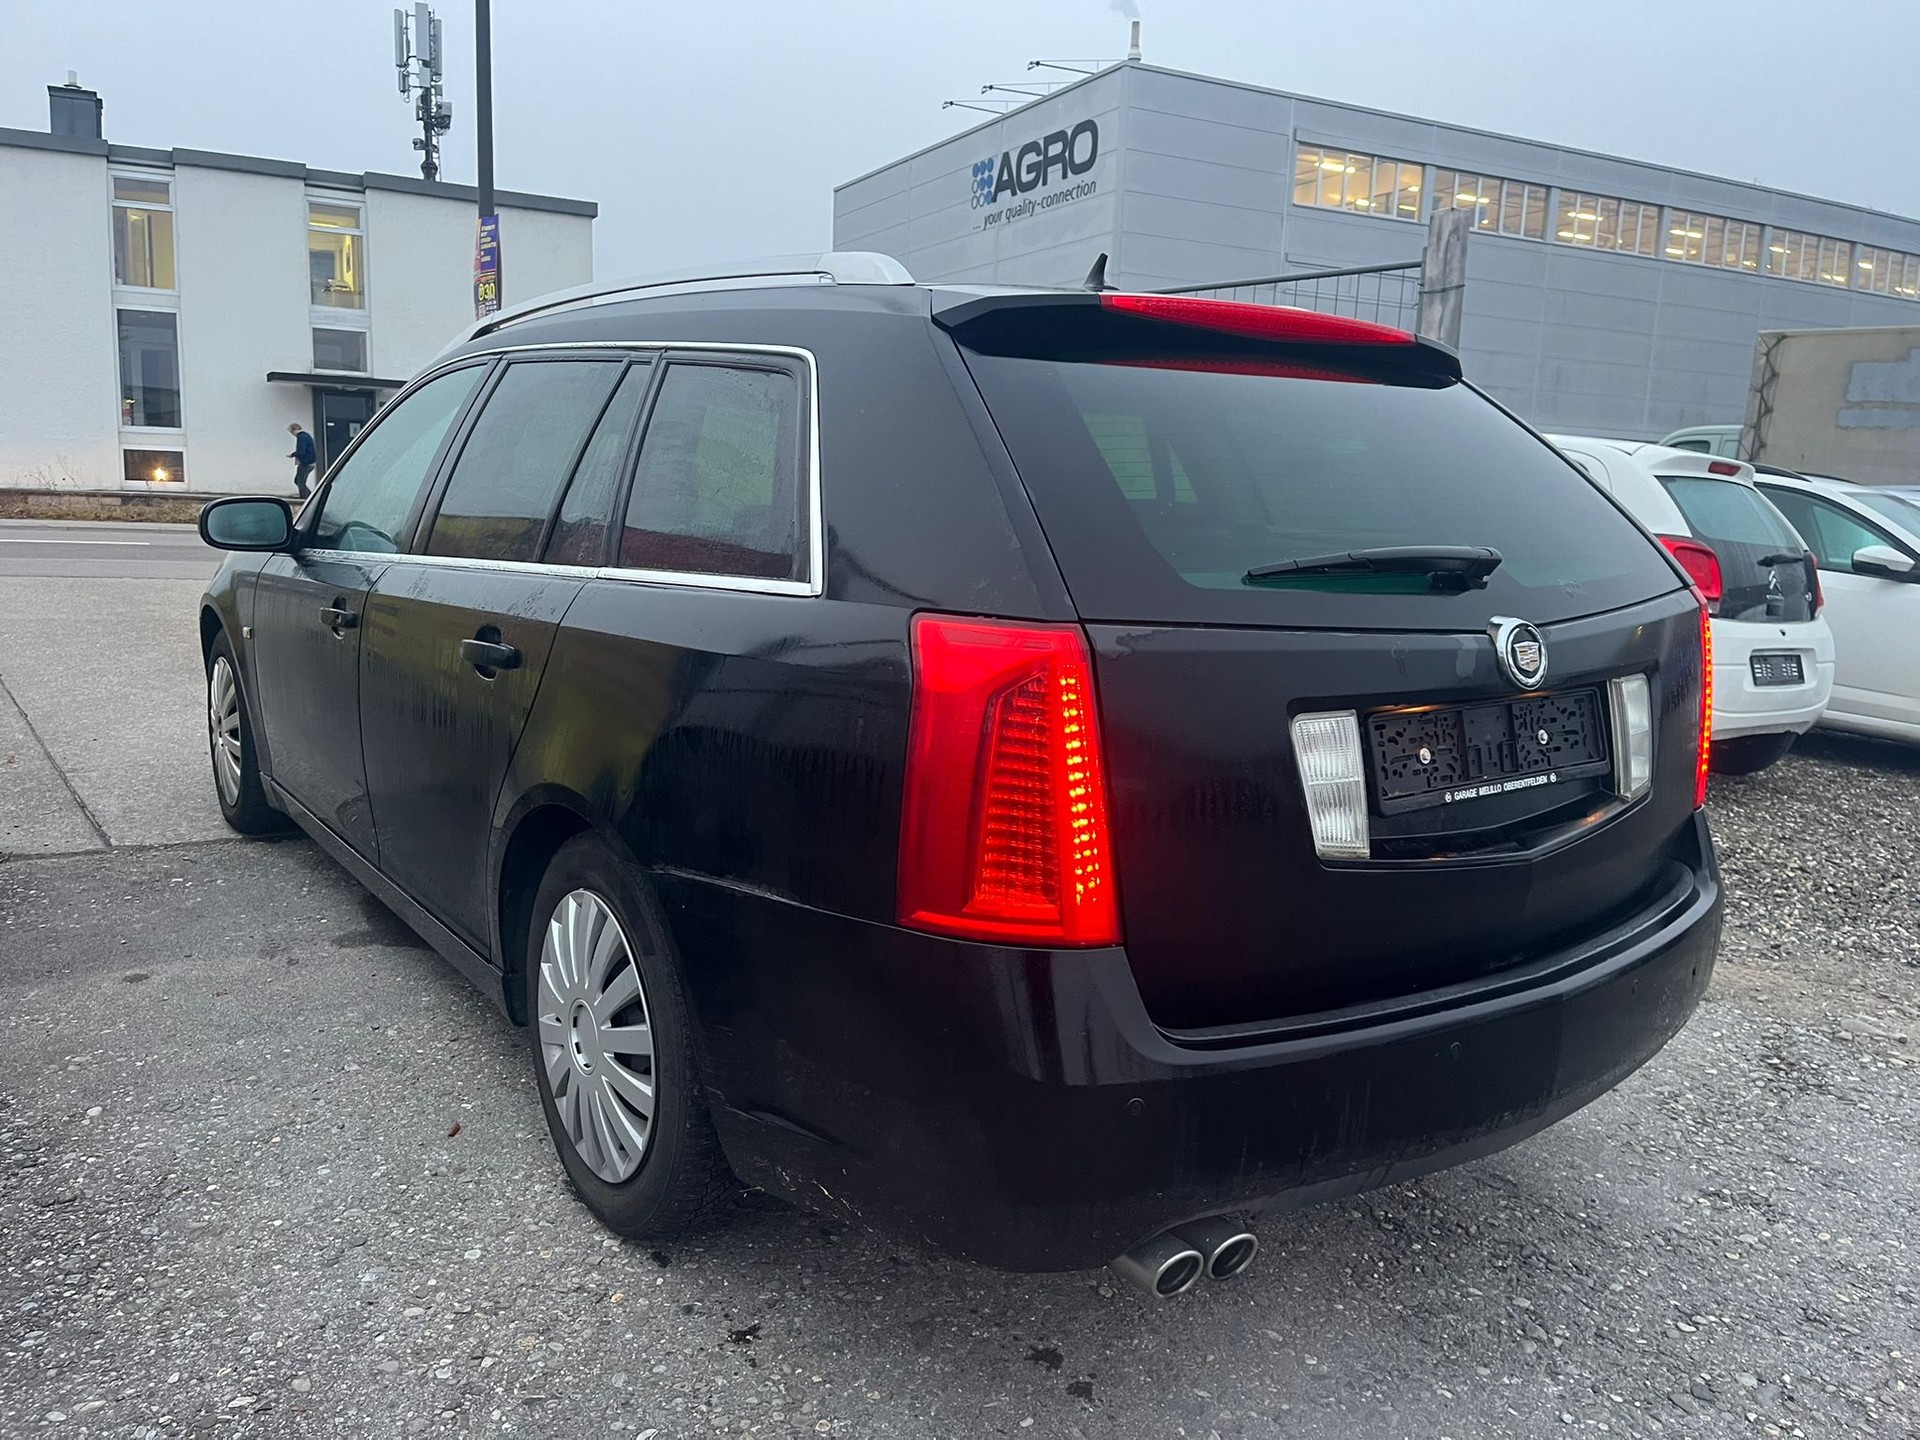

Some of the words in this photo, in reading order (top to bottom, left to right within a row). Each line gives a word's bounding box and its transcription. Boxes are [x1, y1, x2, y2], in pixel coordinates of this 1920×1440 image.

[991, 119, 1099, 203] AGRO
[983, 208, 1004, 231] your
[1005, 180, 1097, 223] quality-connection
[1454, 788, 1478, 801] GARAGE
[1479, 784, 1502, 796] MELILLO
[1503, 775, 1548, 792] OBERENTFELDEN
